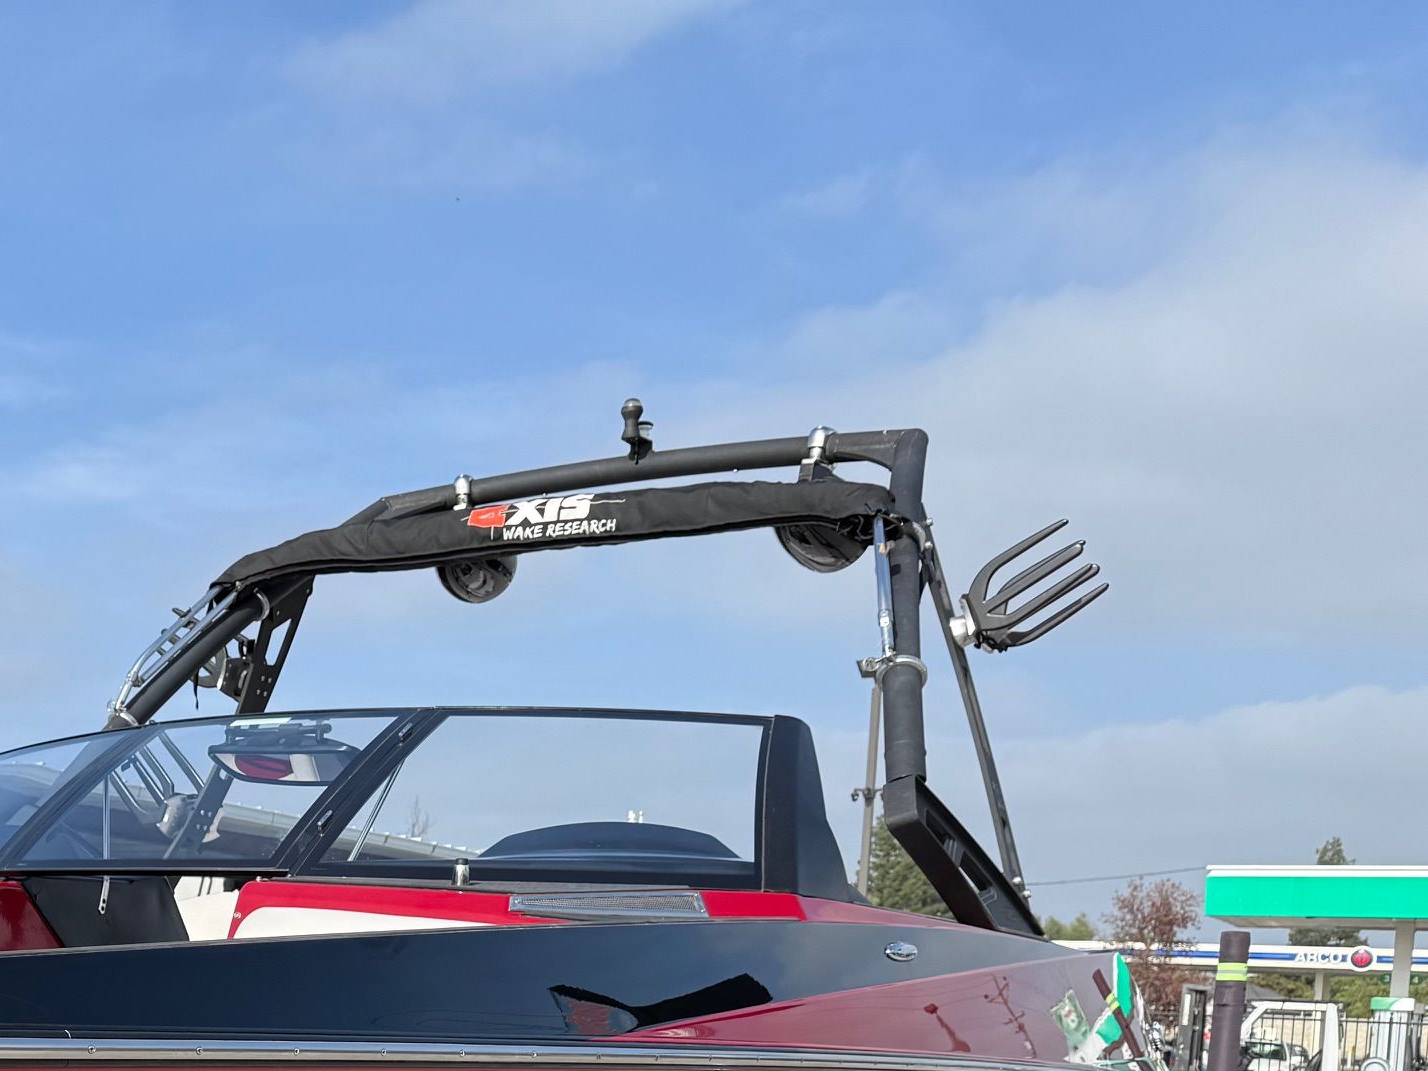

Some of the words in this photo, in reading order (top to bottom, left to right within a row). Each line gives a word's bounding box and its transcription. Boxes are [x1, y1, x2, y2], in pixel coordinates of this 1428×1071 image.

[503, 525, 543, 540] WAKE
[545, 518, 617, 537] RESEARCH
[1294, 952, 1342, 964] ARCO
